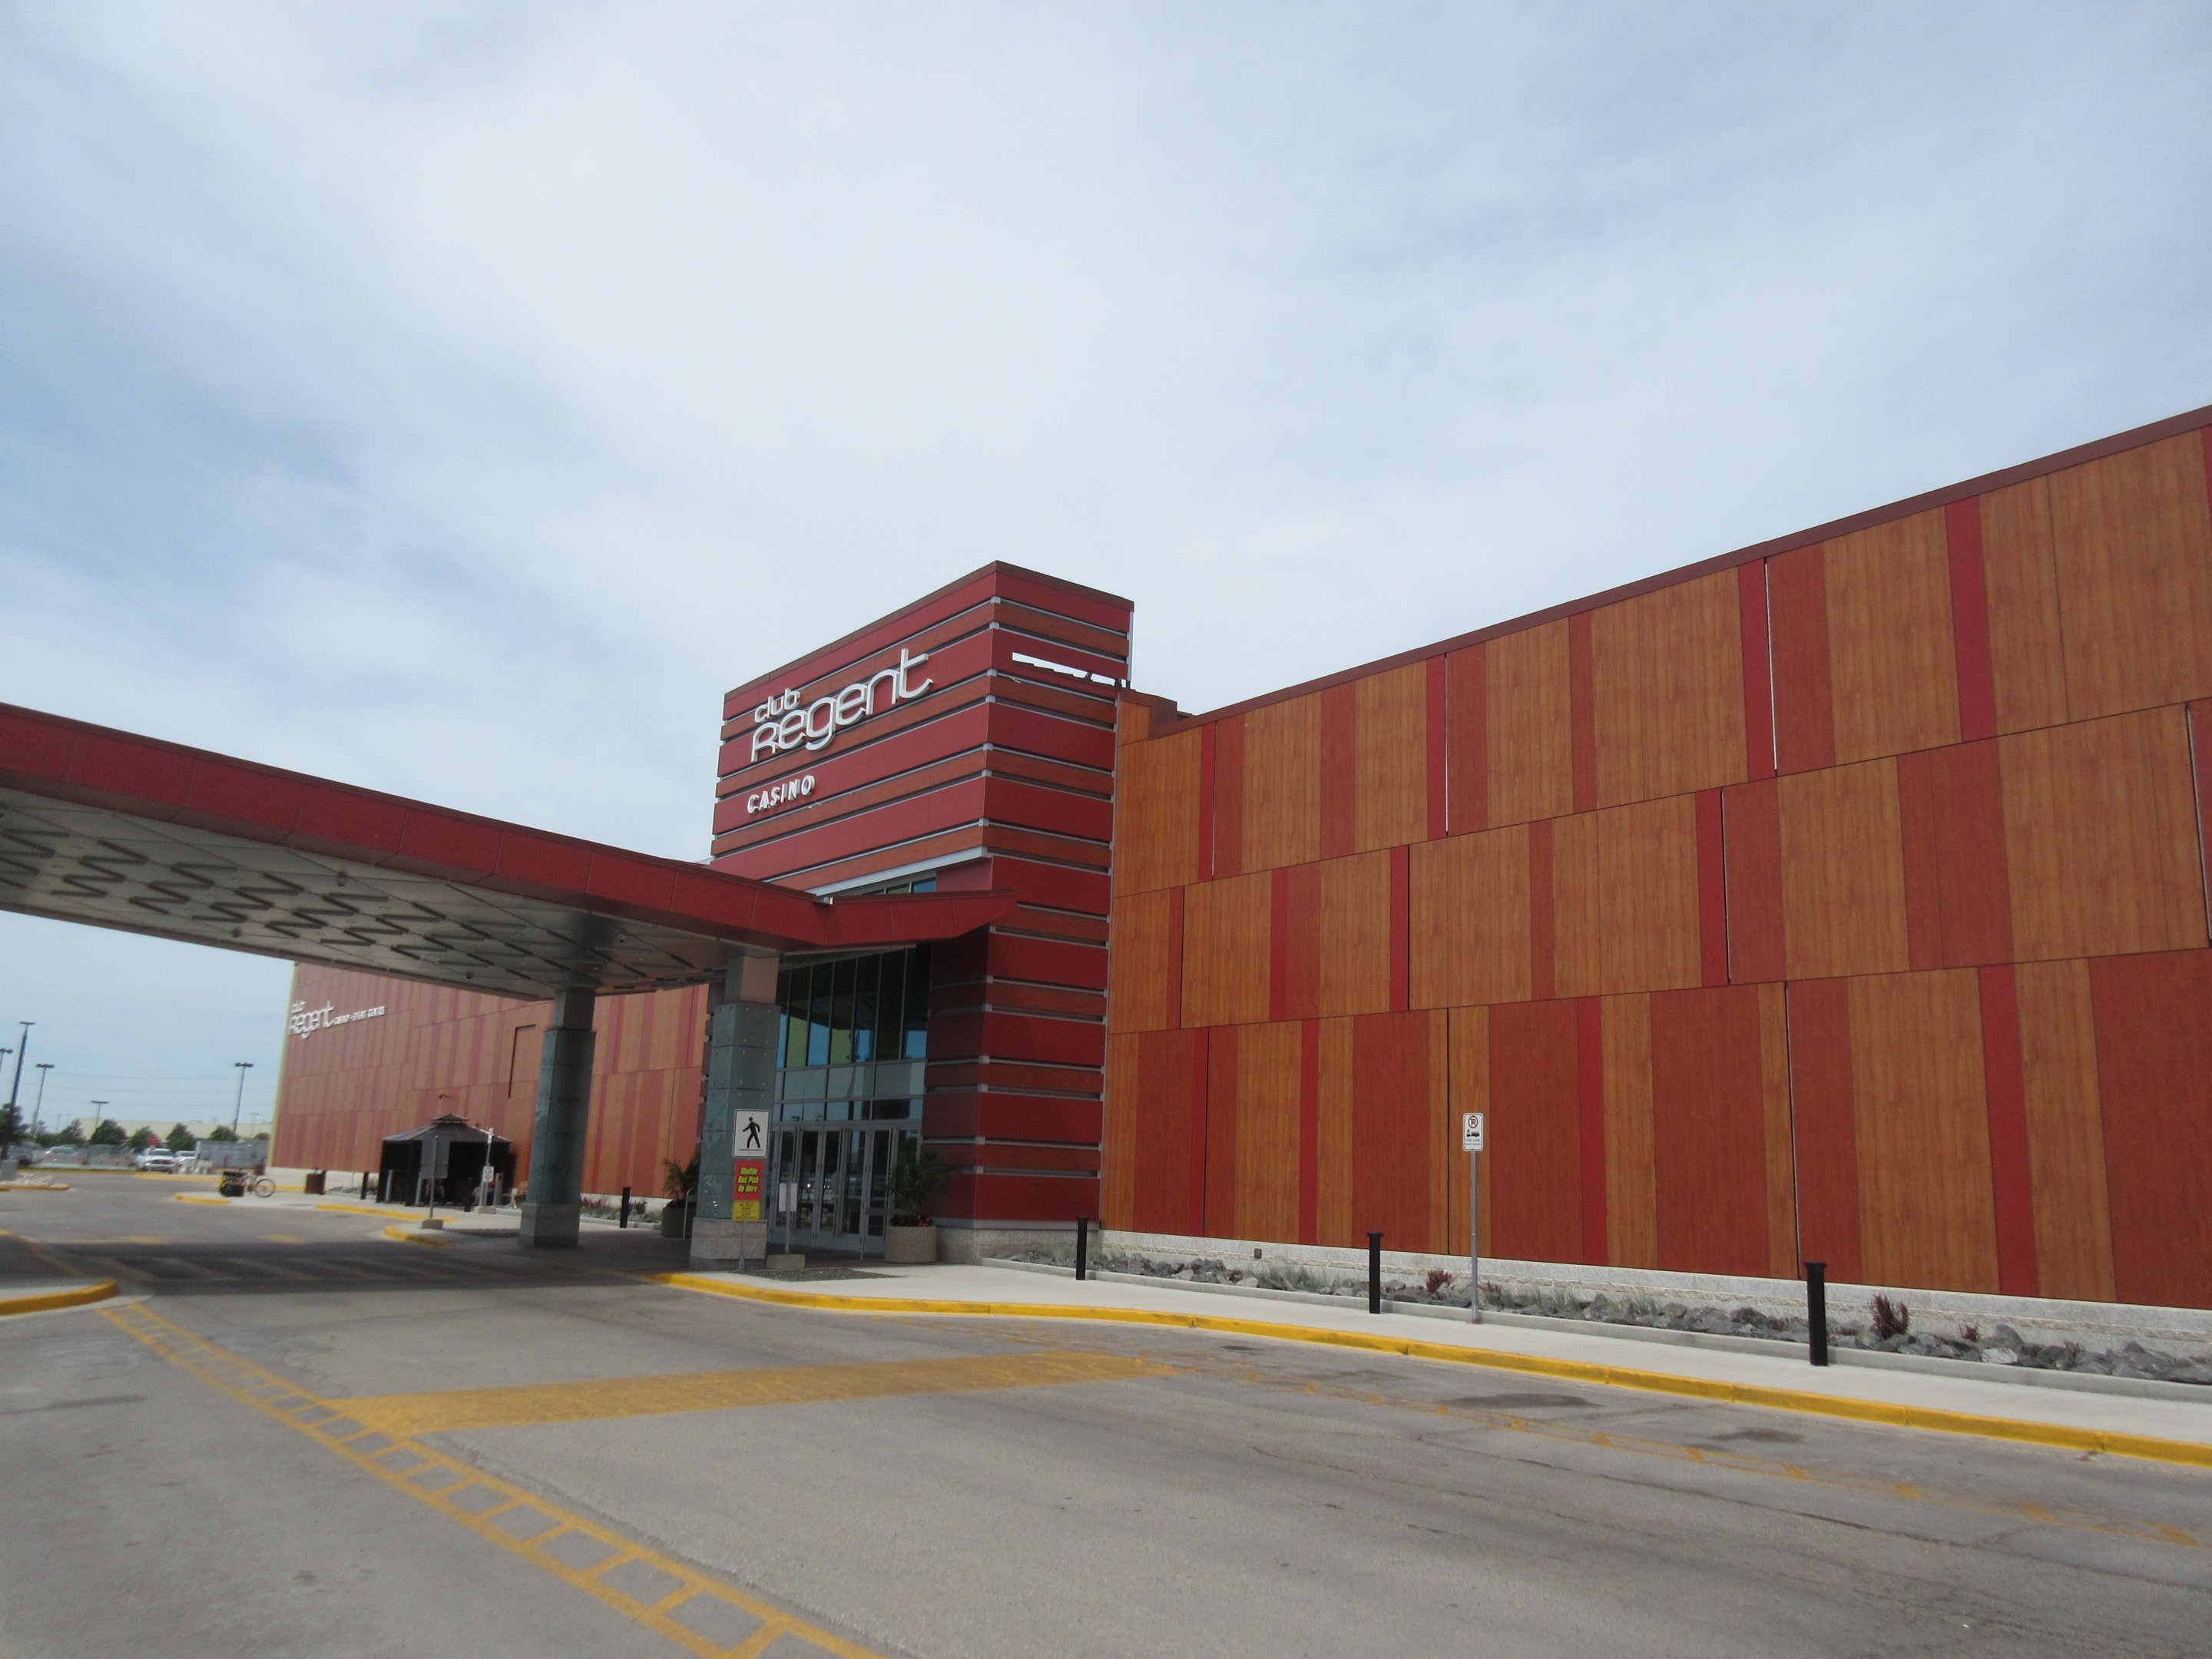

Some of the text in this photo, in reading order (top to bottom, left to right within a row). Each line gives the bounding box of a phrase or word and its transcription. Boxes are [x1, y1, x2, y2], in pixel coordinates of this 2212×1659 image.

[750, 648, 934, 763] Regent
[754, 688, 800, 723] club
[747, 775, 815, 814] CASINO
